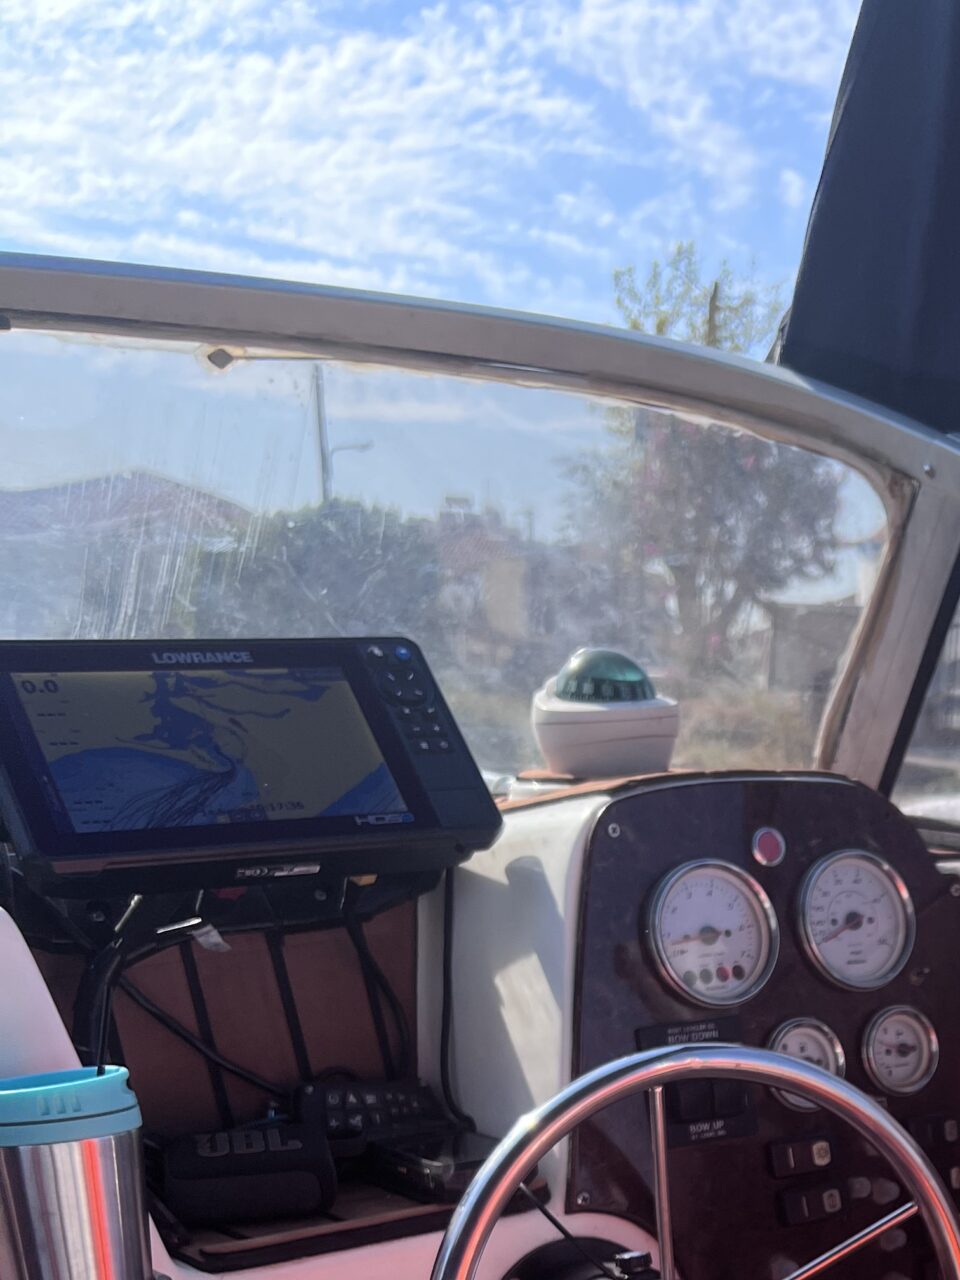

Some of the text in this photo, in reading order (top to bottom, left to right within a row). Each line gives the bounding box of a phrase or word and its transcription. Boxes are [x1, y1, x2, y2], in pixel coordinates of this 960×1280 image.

[152, 651, 254, 664] LOWRANCE
[21, 679, 59, 694] 0.0
[692, 1029, 720, 1041] DOWN
[689, 1119, 725, 1134] BOW UP
[194, 1128, 304, 1157] JBL
